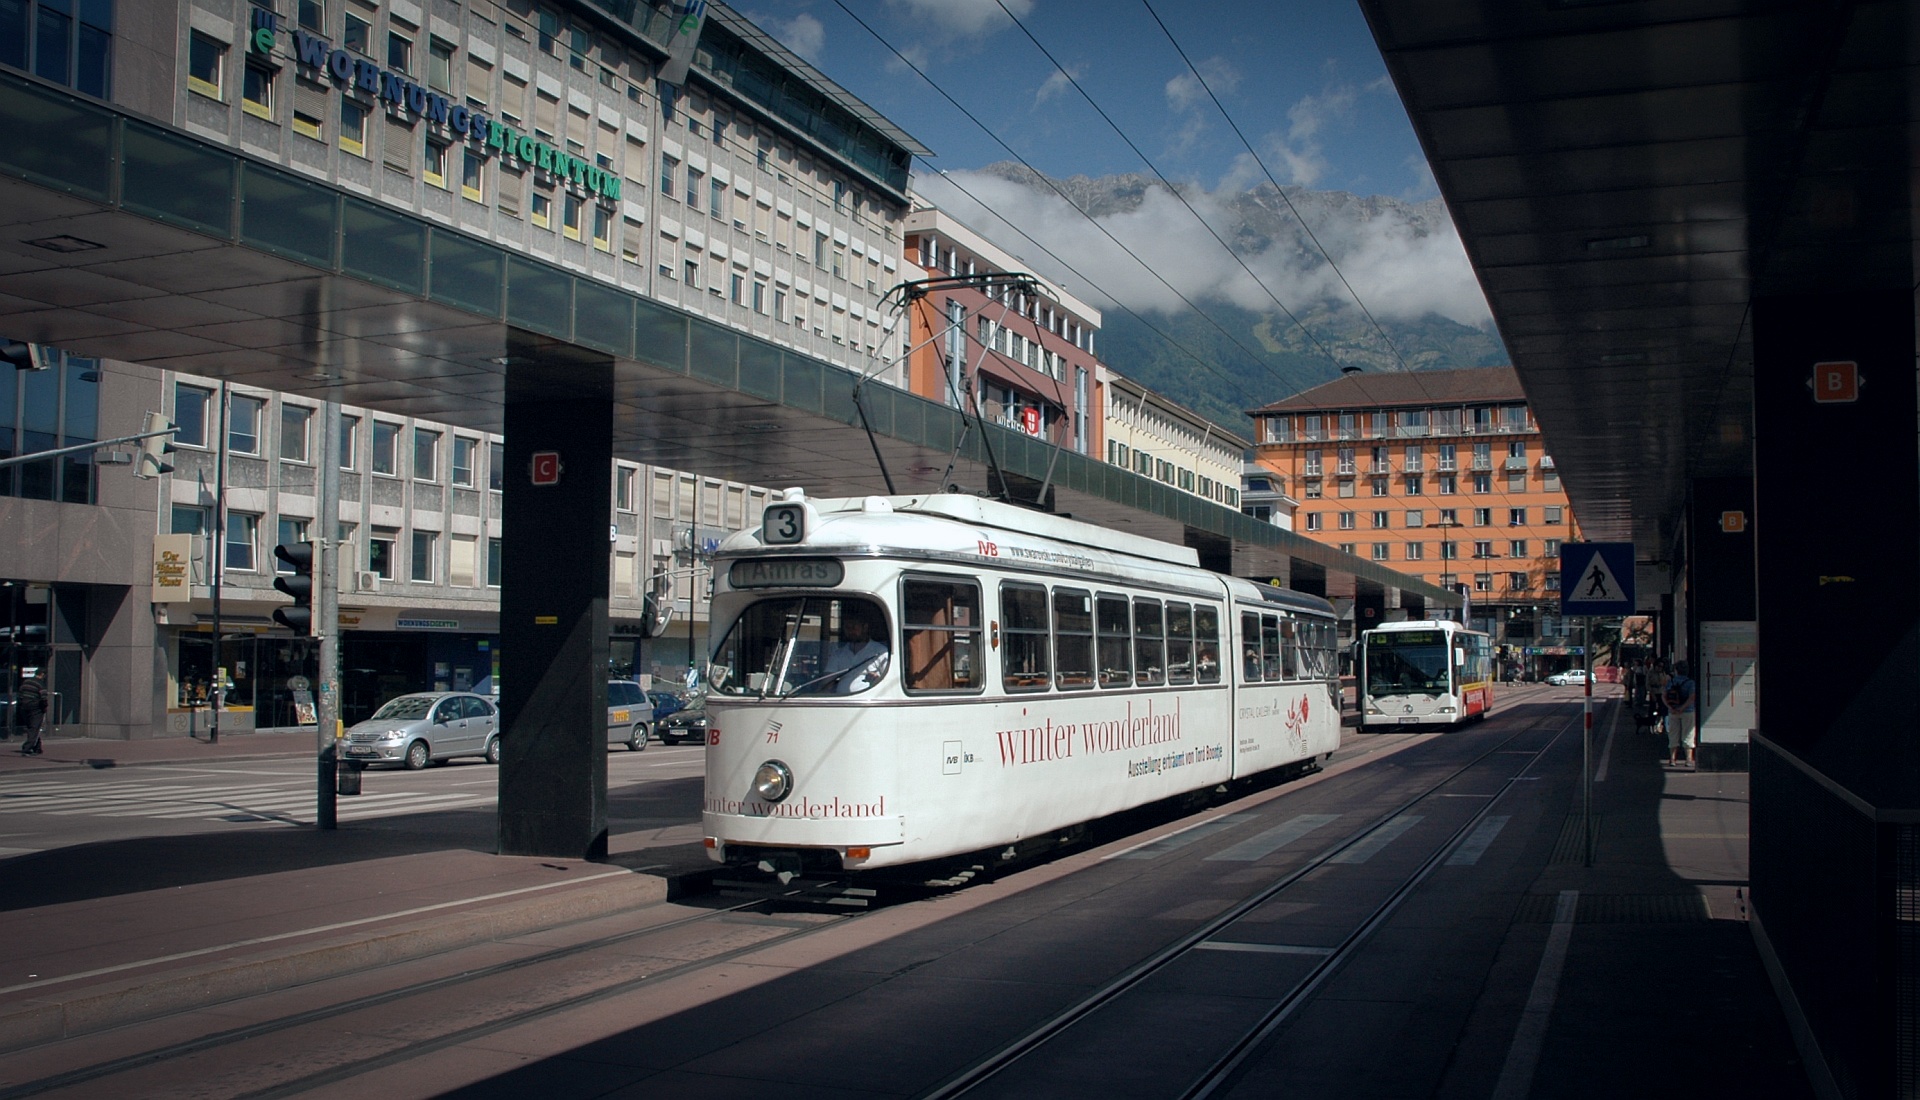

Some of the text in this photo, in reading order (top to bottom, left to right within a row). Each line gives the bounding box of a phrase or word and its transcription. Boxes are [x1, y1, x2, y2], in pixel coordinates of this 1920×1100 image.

[294, 29, 622, 201] WOHNUNGSEIGENTUM
[1828, 372, 1843, 390] B
[540, 461, 550, 475] C
[779, 510, 797, 538] 3
[1729, 516, 1737, 526] B
[977, 540, 998, 556] IVB
[752, 561, 829, 580] Amras
[766, 732, 778, 744] 71
[995, 696, 1181, 769] winter wonderland
[1128, 756, 1161, 778] Ausstellung
[751, 795, 885, 818] wonderland
